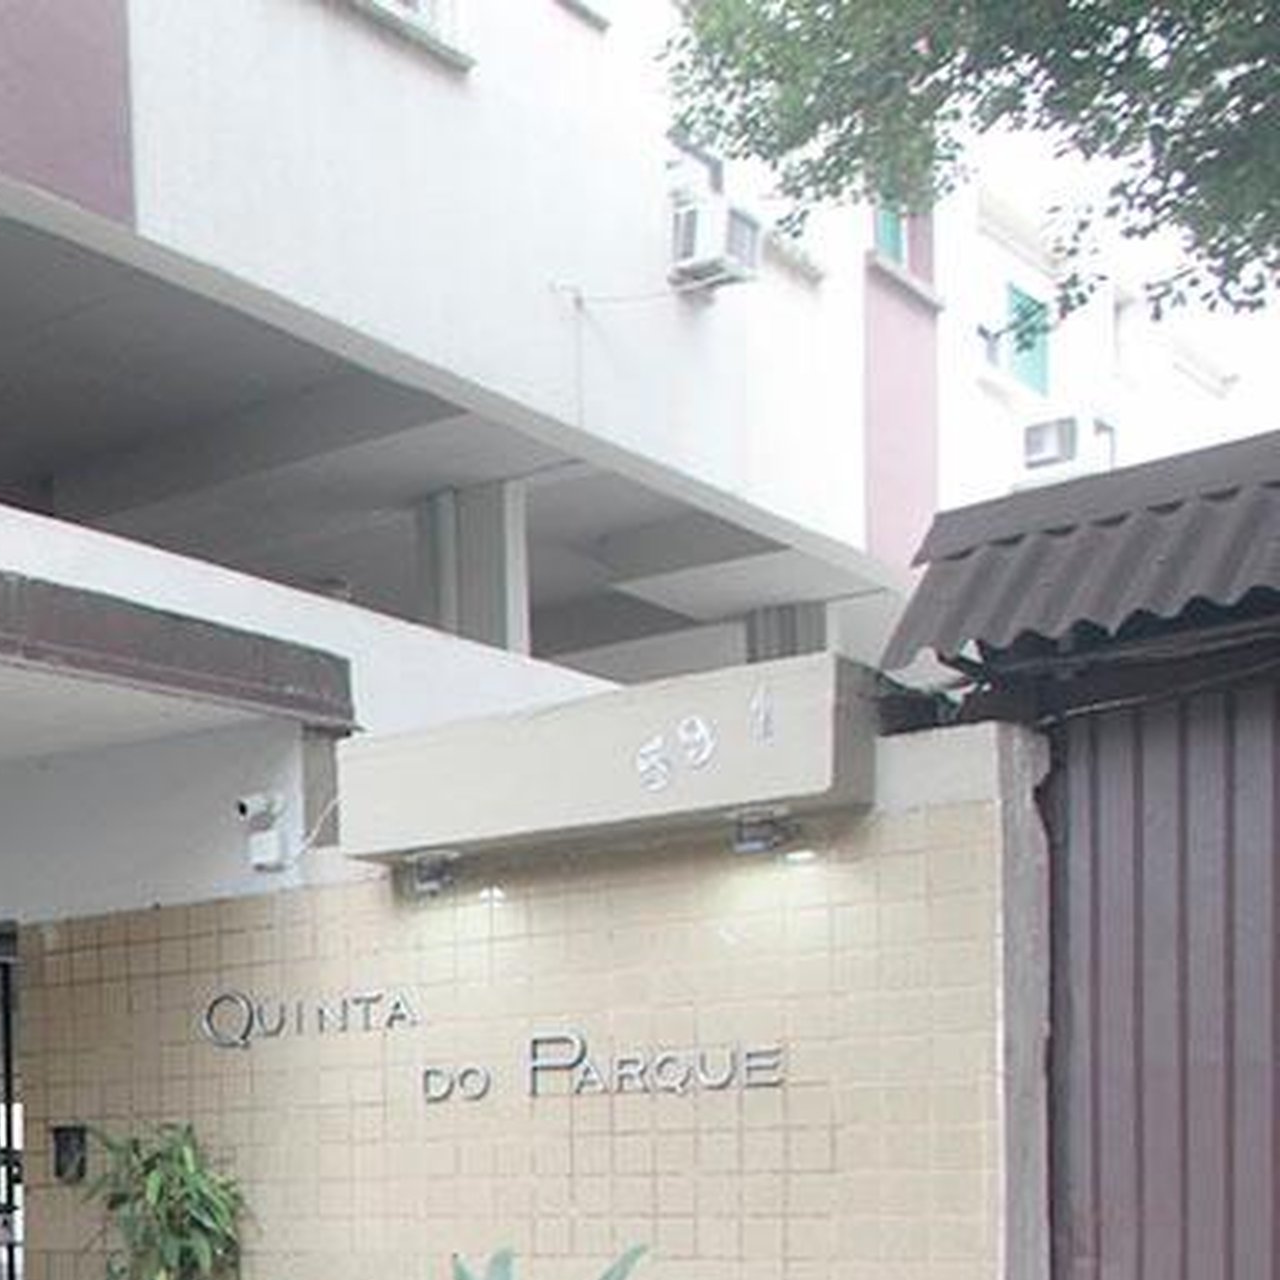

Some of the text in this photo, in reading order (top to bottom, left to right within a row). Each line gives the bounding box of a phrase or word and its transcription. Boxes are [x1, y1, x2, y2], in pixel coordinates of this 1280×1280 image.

[202, 989, 420, 1050] QUINTA
[422, 1030, 785, 1103] DO PARQUE
